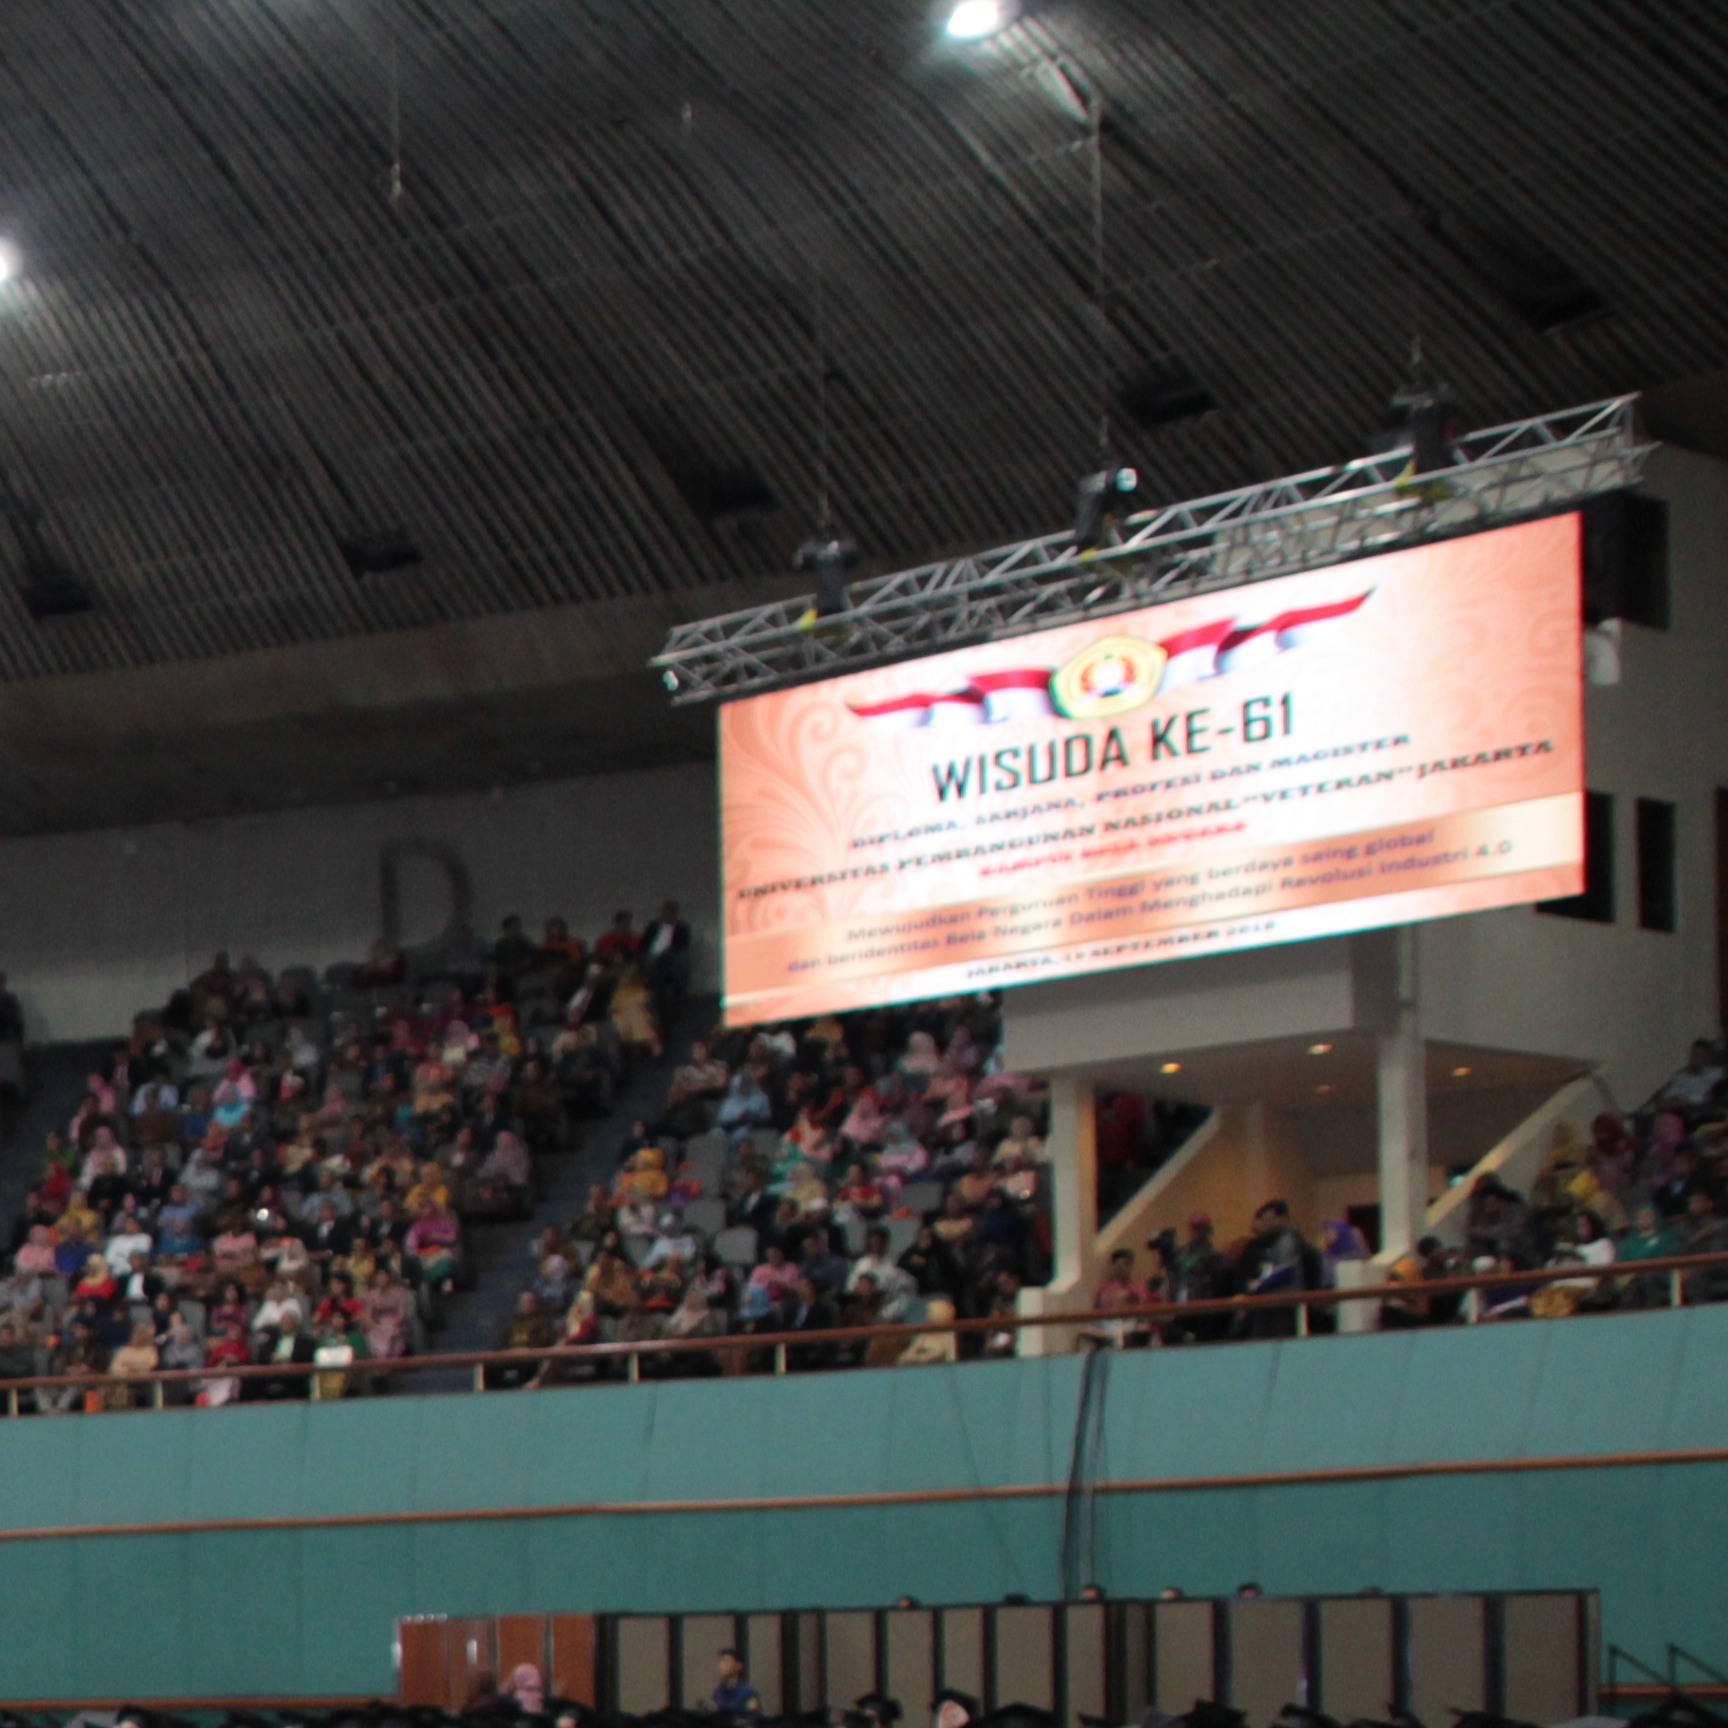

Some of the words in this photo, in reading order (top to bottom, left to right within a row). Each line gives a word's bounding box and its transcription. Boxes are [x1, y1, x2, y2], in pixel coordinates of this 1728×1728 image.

[932, 726, 1130, 803] WISUDA
[1149, 691, 1294, 762] KE-61
[1365, 827, 1437, 858] global
